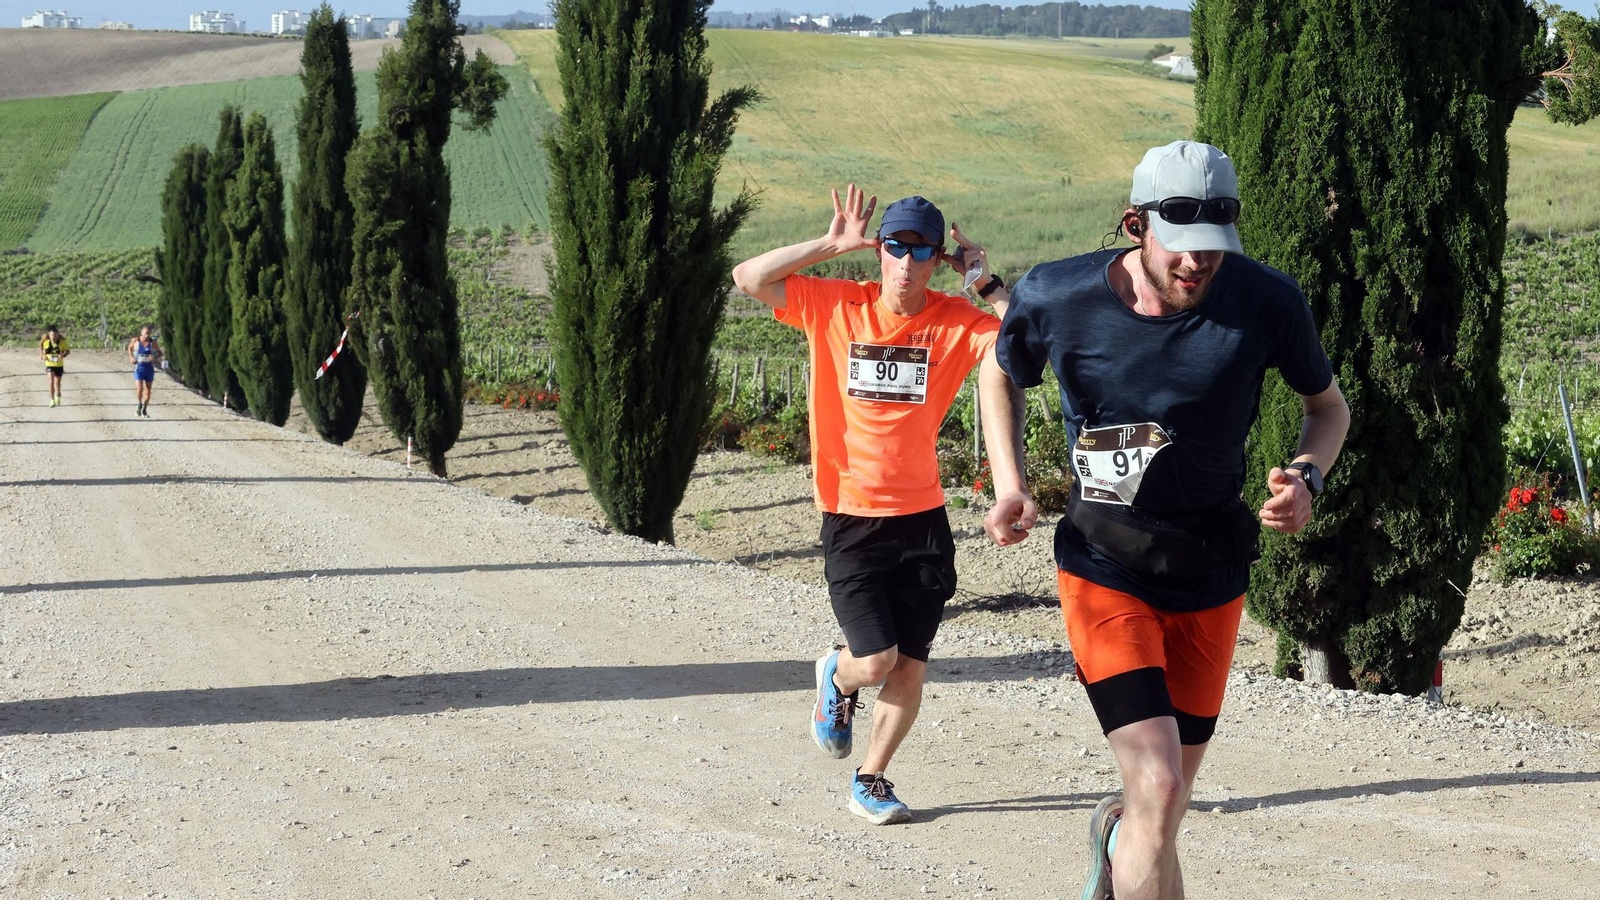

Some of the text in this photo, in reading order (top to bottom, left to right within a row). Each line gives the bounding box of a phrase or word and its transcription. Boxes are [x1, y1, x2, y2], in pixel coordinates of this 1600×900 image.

[876, 362, 898, 381] 90
[1118, 426, 1136, 449] JJP
[1113, 448, 1143, 477] 91
